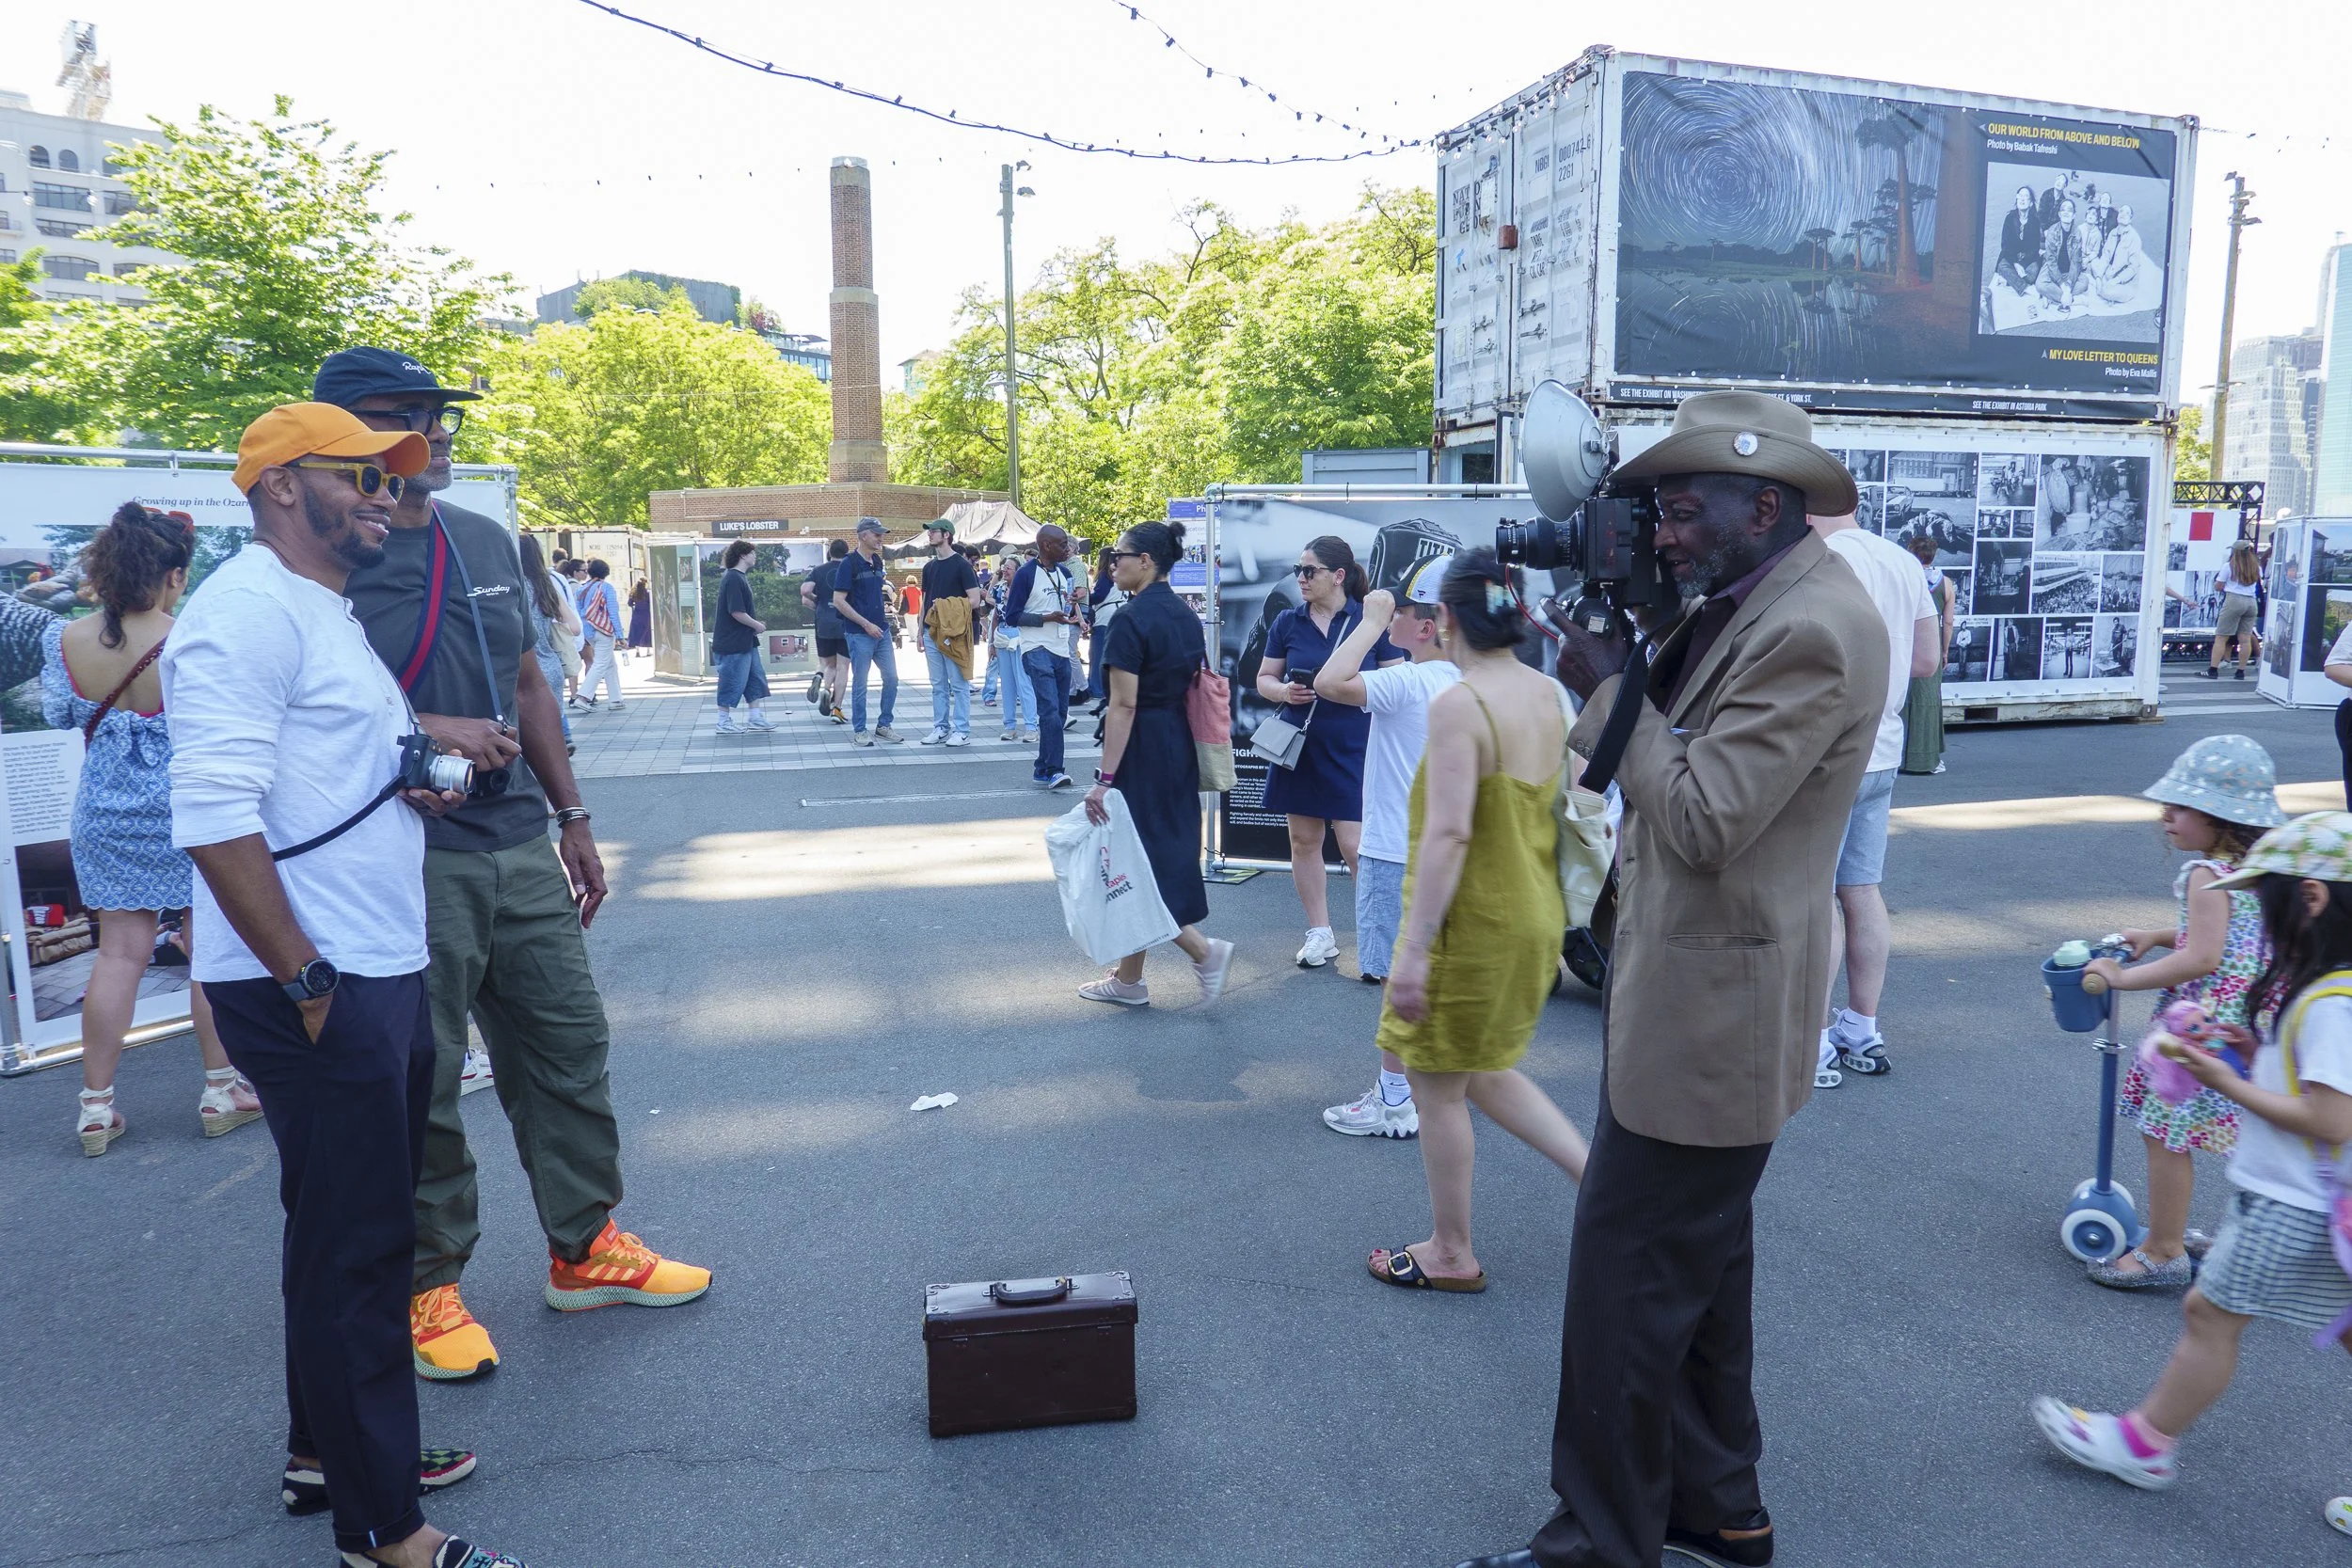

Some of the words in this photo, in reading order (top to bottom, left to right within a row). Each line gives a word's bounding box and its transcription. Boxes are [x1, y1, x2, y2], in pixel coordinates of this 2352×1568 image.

[1988, 123, 2007, 135] OUR
[2008, 125, 2039, 138] WORLD
[2040, 128, 2064, 140] FROM
[2065, 131, 2093, 144] ABOVE
[2093, 134, 2111, 146] AND
[2111, 135, 2140, 149] BELOW
[1987, 138, 2006, 149] Photo
[2006, 141, 2013, 151] by
[2014, 142, 2033, 152] Babak
[2034, 143, 2058, 154] Tafreshi
[2049, 349, 2063, 359] MY
[2063, 350, 2084, 361] LOVE
[2084, 351, 2115, 363] LETTER
[2115, 353, 2126, 363] TO
[2126, 354, 2158, 365] QUEENS
[2105, 367, 2122, 376] Photo
[2122, 367, 2130, 378] by
[2129, 369, 2141, 377] Eva
[1620, 388, 1631, 397] SEE
[1631, 388, 1643, 398] THE
[1642, 388, 1664, 399] EXHIBIT
[1663, 389, 1672, 399] ON
[1672, 390, 1708, 399] WASHING
[1790, 393, 1804, 403] YORK
[1804, 394, 1812, 404] ST.
[1972, 400, 1982, 409] SEE
[1981, 401, 1993, 410] THE
[1991, 401, 2010, 410] EXHIBIT
[2010, 402, 2016, 410] IN
[2015, 402, 2035, 411] ASTORIA
[2034, 403, 2048, 411] PARK
[179, 499, 192, 508] up
[194, 498, 203, 506] in
[205, 497, 221, 507] the
[222, 498, 249, 507] Ozar
[720, 522, 745, 531] LUKE'S
[746, 521, 779, 531] LOBSTER
[472, 584, 511, 594] Sunday
[1232, 748, 1259, 758] FIGH
